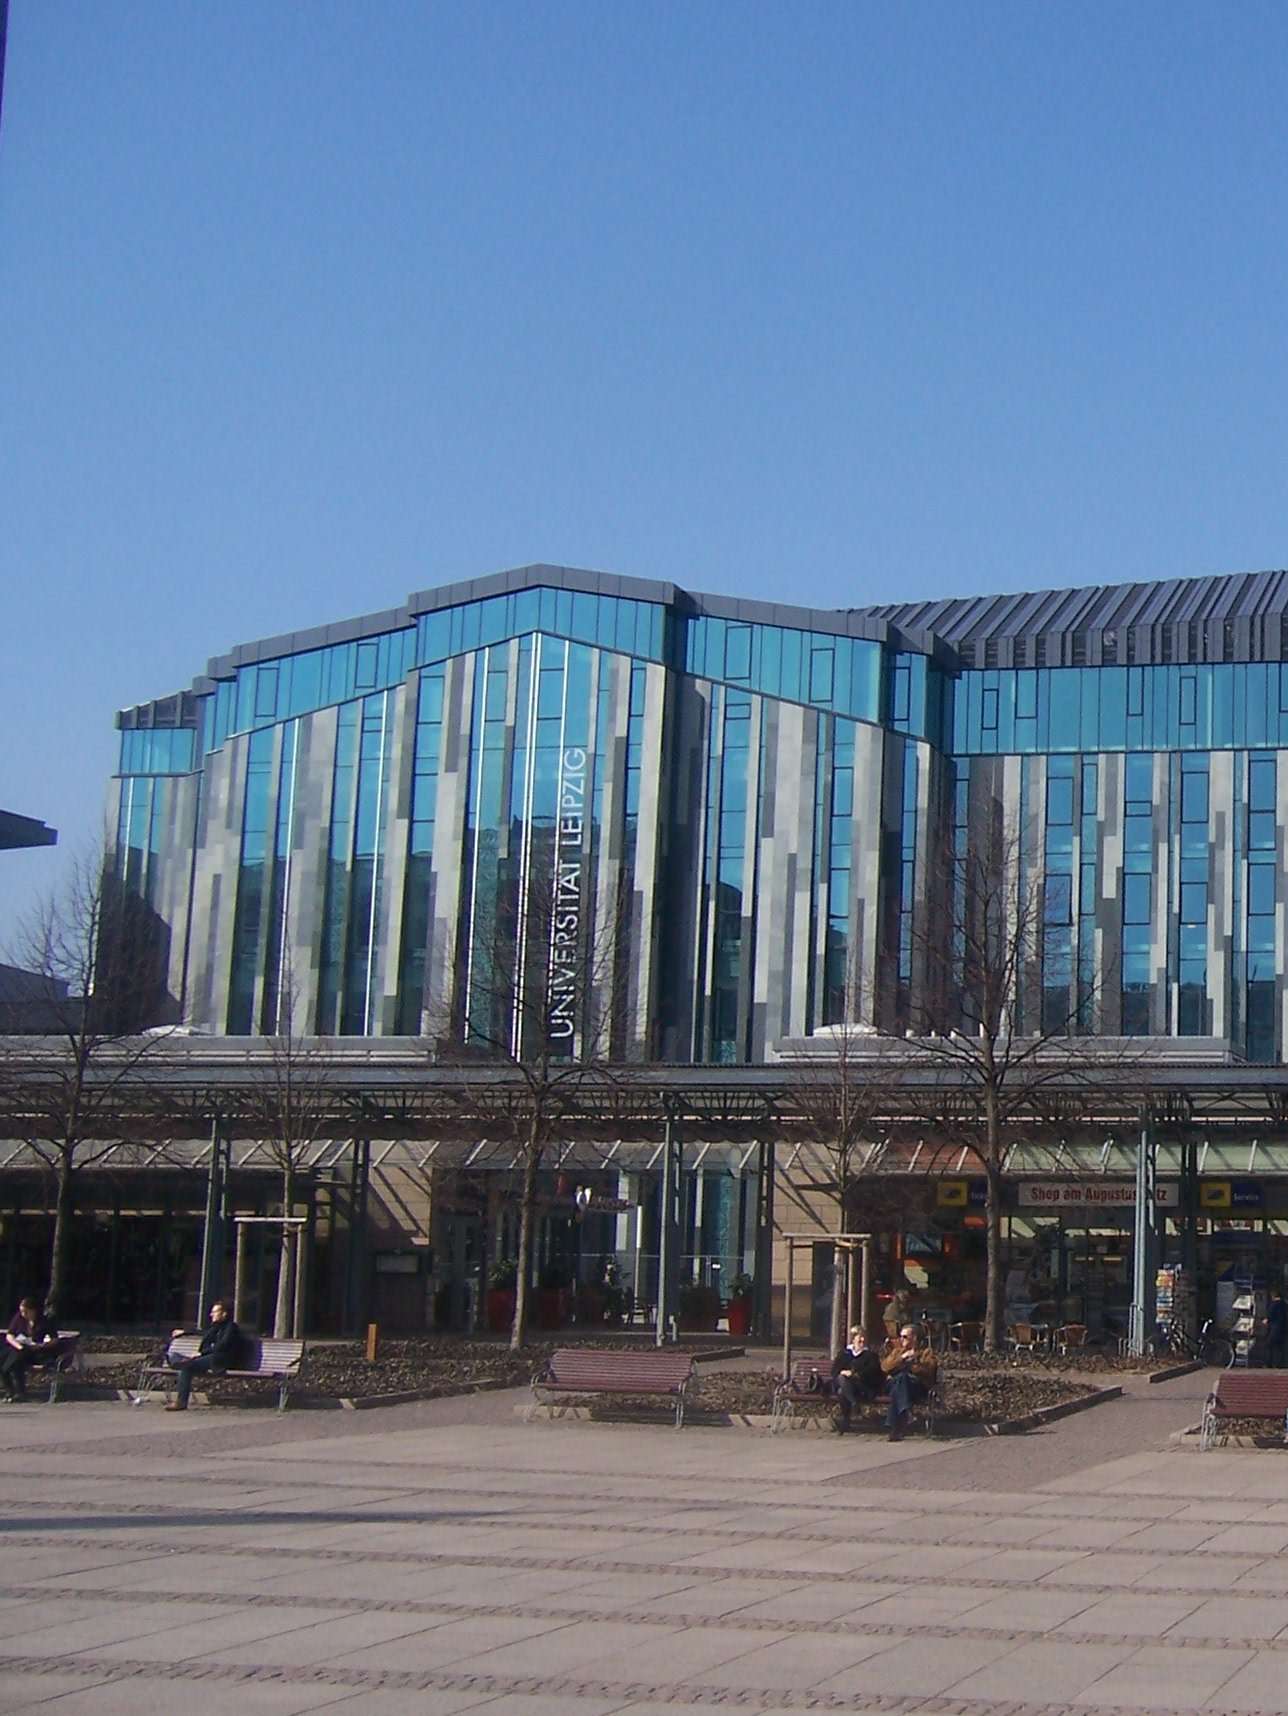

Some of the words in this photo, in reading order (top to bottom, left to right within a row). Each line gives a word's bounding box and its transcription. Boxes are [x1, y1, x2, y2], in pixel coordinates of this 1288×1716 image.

[561, 748, 587, 846] LEIPZIG
[550, 859, 581, 1038] UNIVERSITÄT
[1031, 1187, 1059, 1202] Shop
[1063, 1188, 1082, 1201] am
